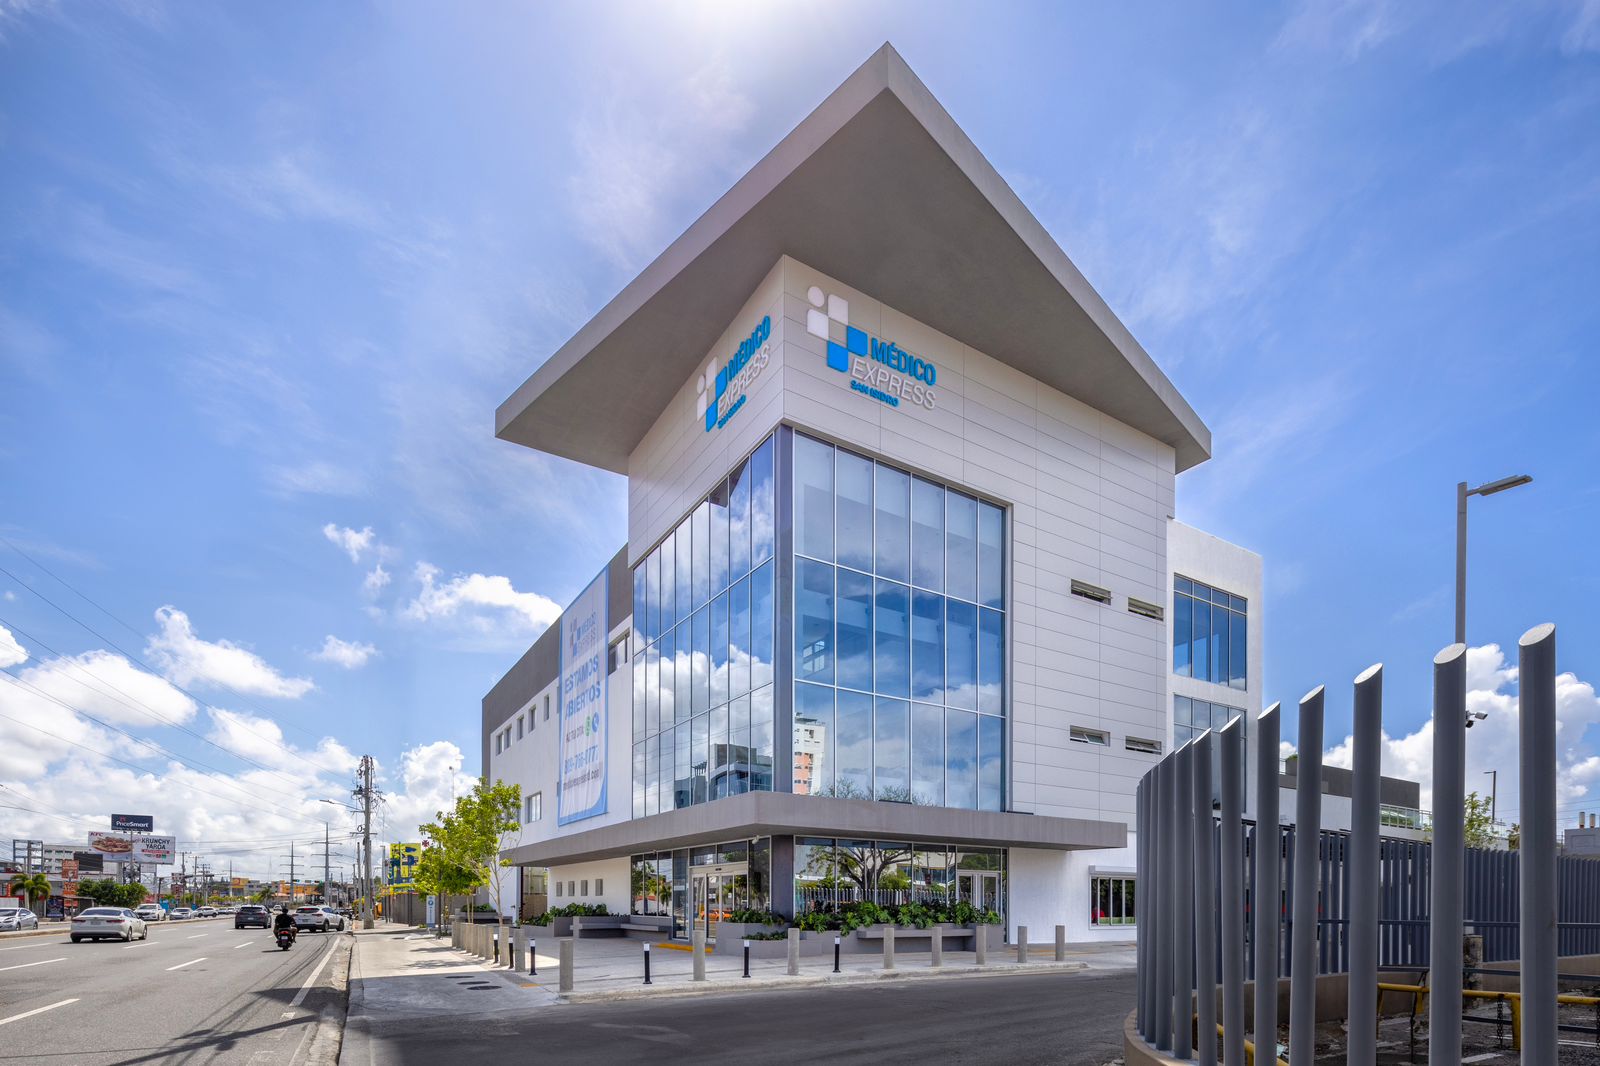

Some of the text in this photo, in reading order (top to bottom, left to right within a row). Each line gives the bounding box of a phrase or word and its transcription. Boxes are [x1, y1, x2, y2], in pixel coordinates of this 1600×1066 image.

[727, 315, 771, 382] MÉDICO
[871, 337, 936, 386] MÉDICO
[718, 344, 770, 419] EXPRESS
[850, 380, 899, 408] SAN ISIDRO
[851, 357, 936, 410] EXPRESS
[565, 654, 599, 694] ESTAMOS
[565, 680, 601, 721] ABIERTOS
[116, 820, 149, 828] PriceSmart
[141, 837, 171, 845] KRUNCHY
